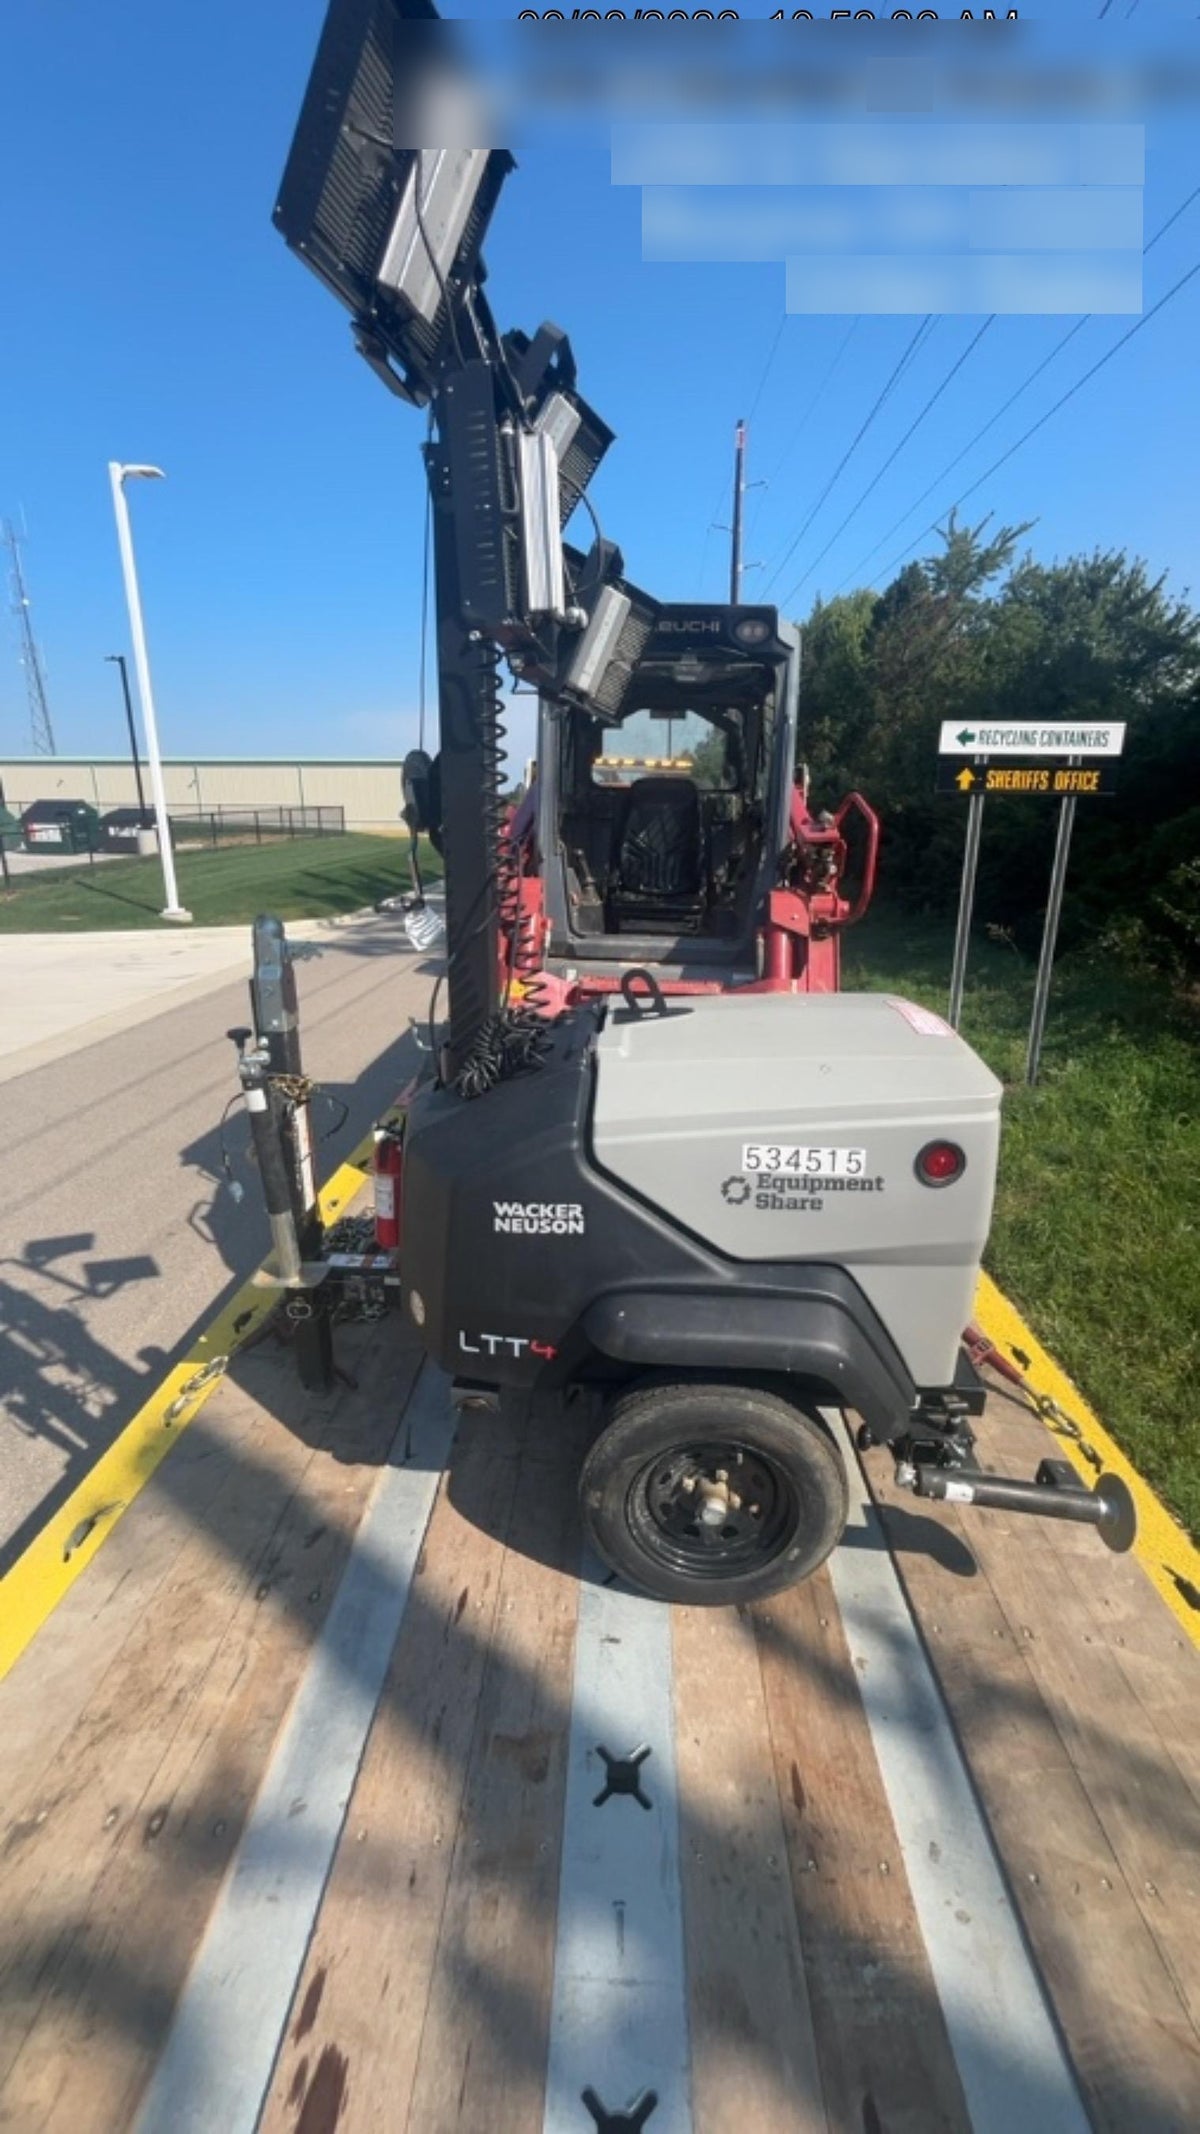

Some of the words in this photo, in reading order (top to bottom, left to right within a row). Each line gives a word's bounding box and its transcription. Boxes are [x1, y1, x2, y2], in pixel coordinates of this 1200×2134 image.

[655, 620, 720, 632] EUCHI
[978, 730, 1037, 747] RECYCLING
[1040, 730, 1110, 747] CONTAINERS
[1054, 769, 1100, 790] OFFICE
[745, 1147, 863, 1174] 534515
[755, 1173, 885, 1194] Equipment
[493, 1201, 584, 1219] WACKER
[755, 1192, 824, 1211] Share
[494, 1218, 585, 1235] NEUSON
[459, 1330, 558, 1360] LTT4
